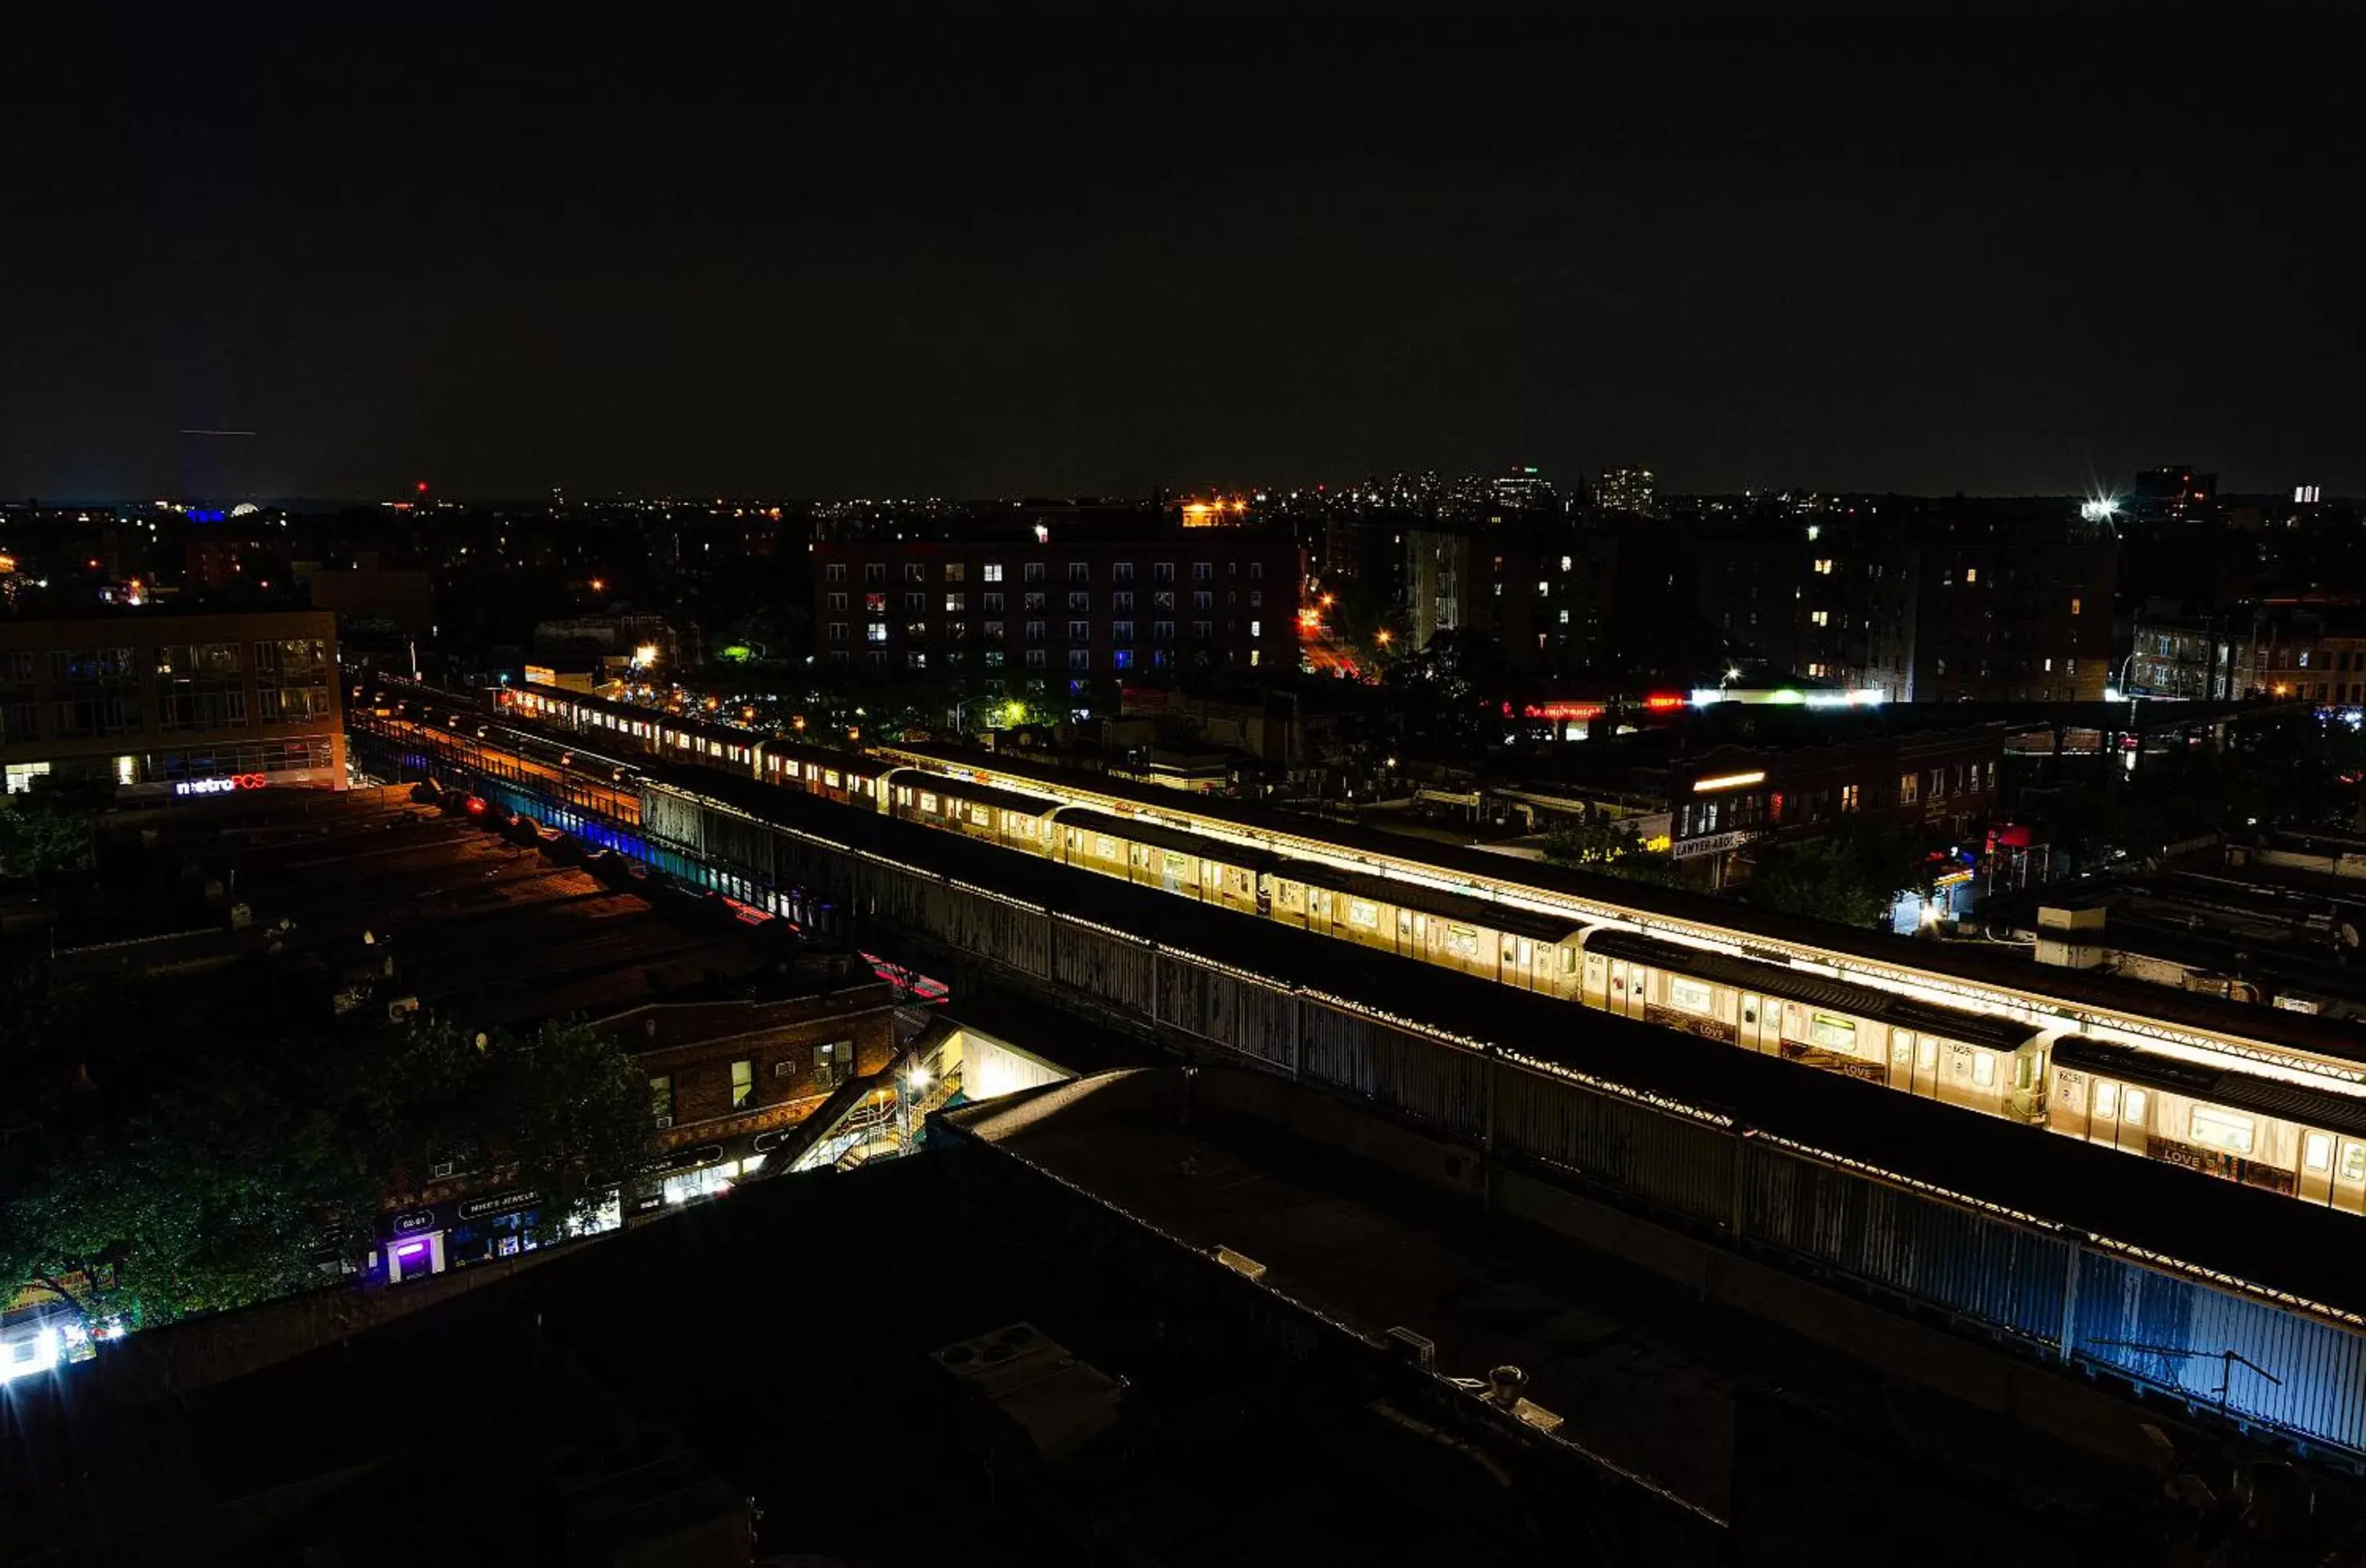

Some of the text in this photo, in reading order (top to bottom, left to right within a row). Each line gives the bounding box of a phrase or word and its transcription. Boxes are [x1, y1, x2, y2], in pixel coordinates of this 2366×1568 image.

[177, 773, 266, 795] metroPCS
[1699, 1024, 1724, 1039] LOVE
[1843, 1064, 1872, 1078] LOVE
[2163, 1148, 2200, 1168] LOVE
